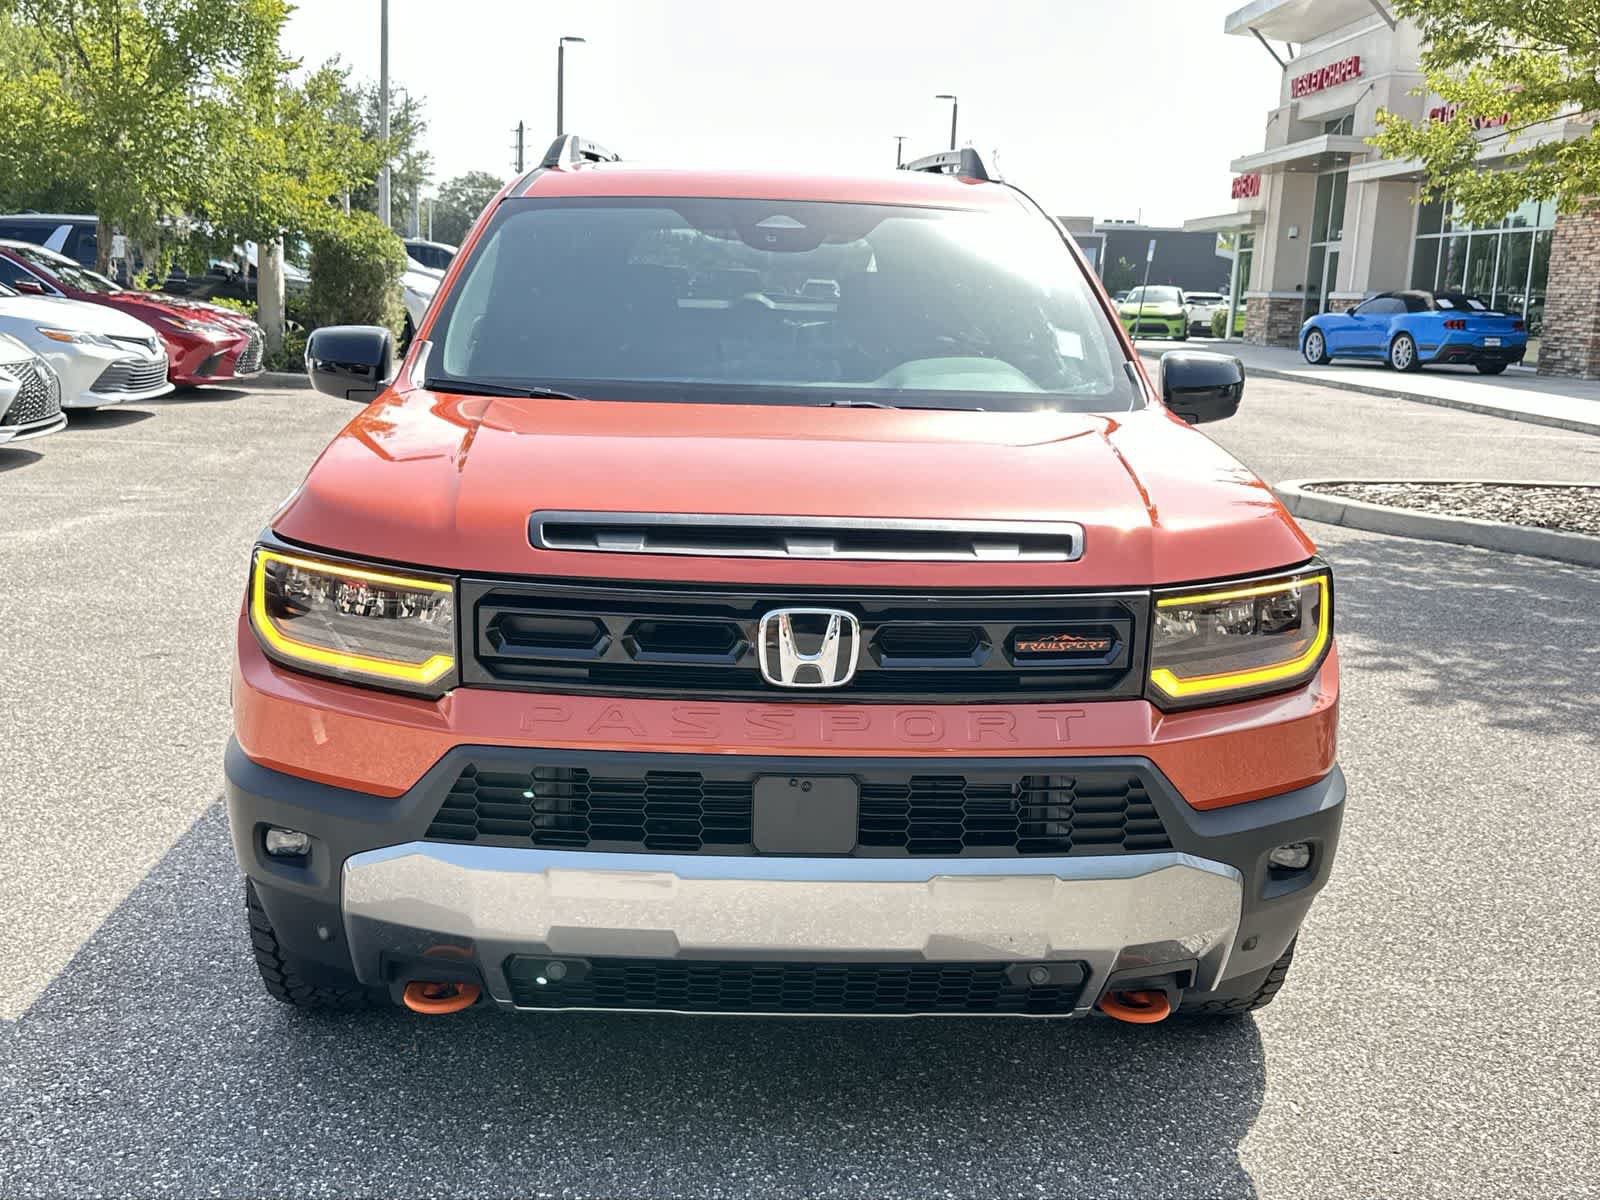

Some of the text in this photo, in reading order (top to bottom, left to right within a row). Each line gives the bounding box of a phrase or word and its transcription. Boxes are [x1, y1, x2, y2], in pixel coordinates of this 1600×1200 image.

[1291, 55, 1361, 99] WESLEY CHAPEL
[1016, 641, 1108, 651] TRAILSPORT
[519, 703, 1086, 744] PASSPORT
